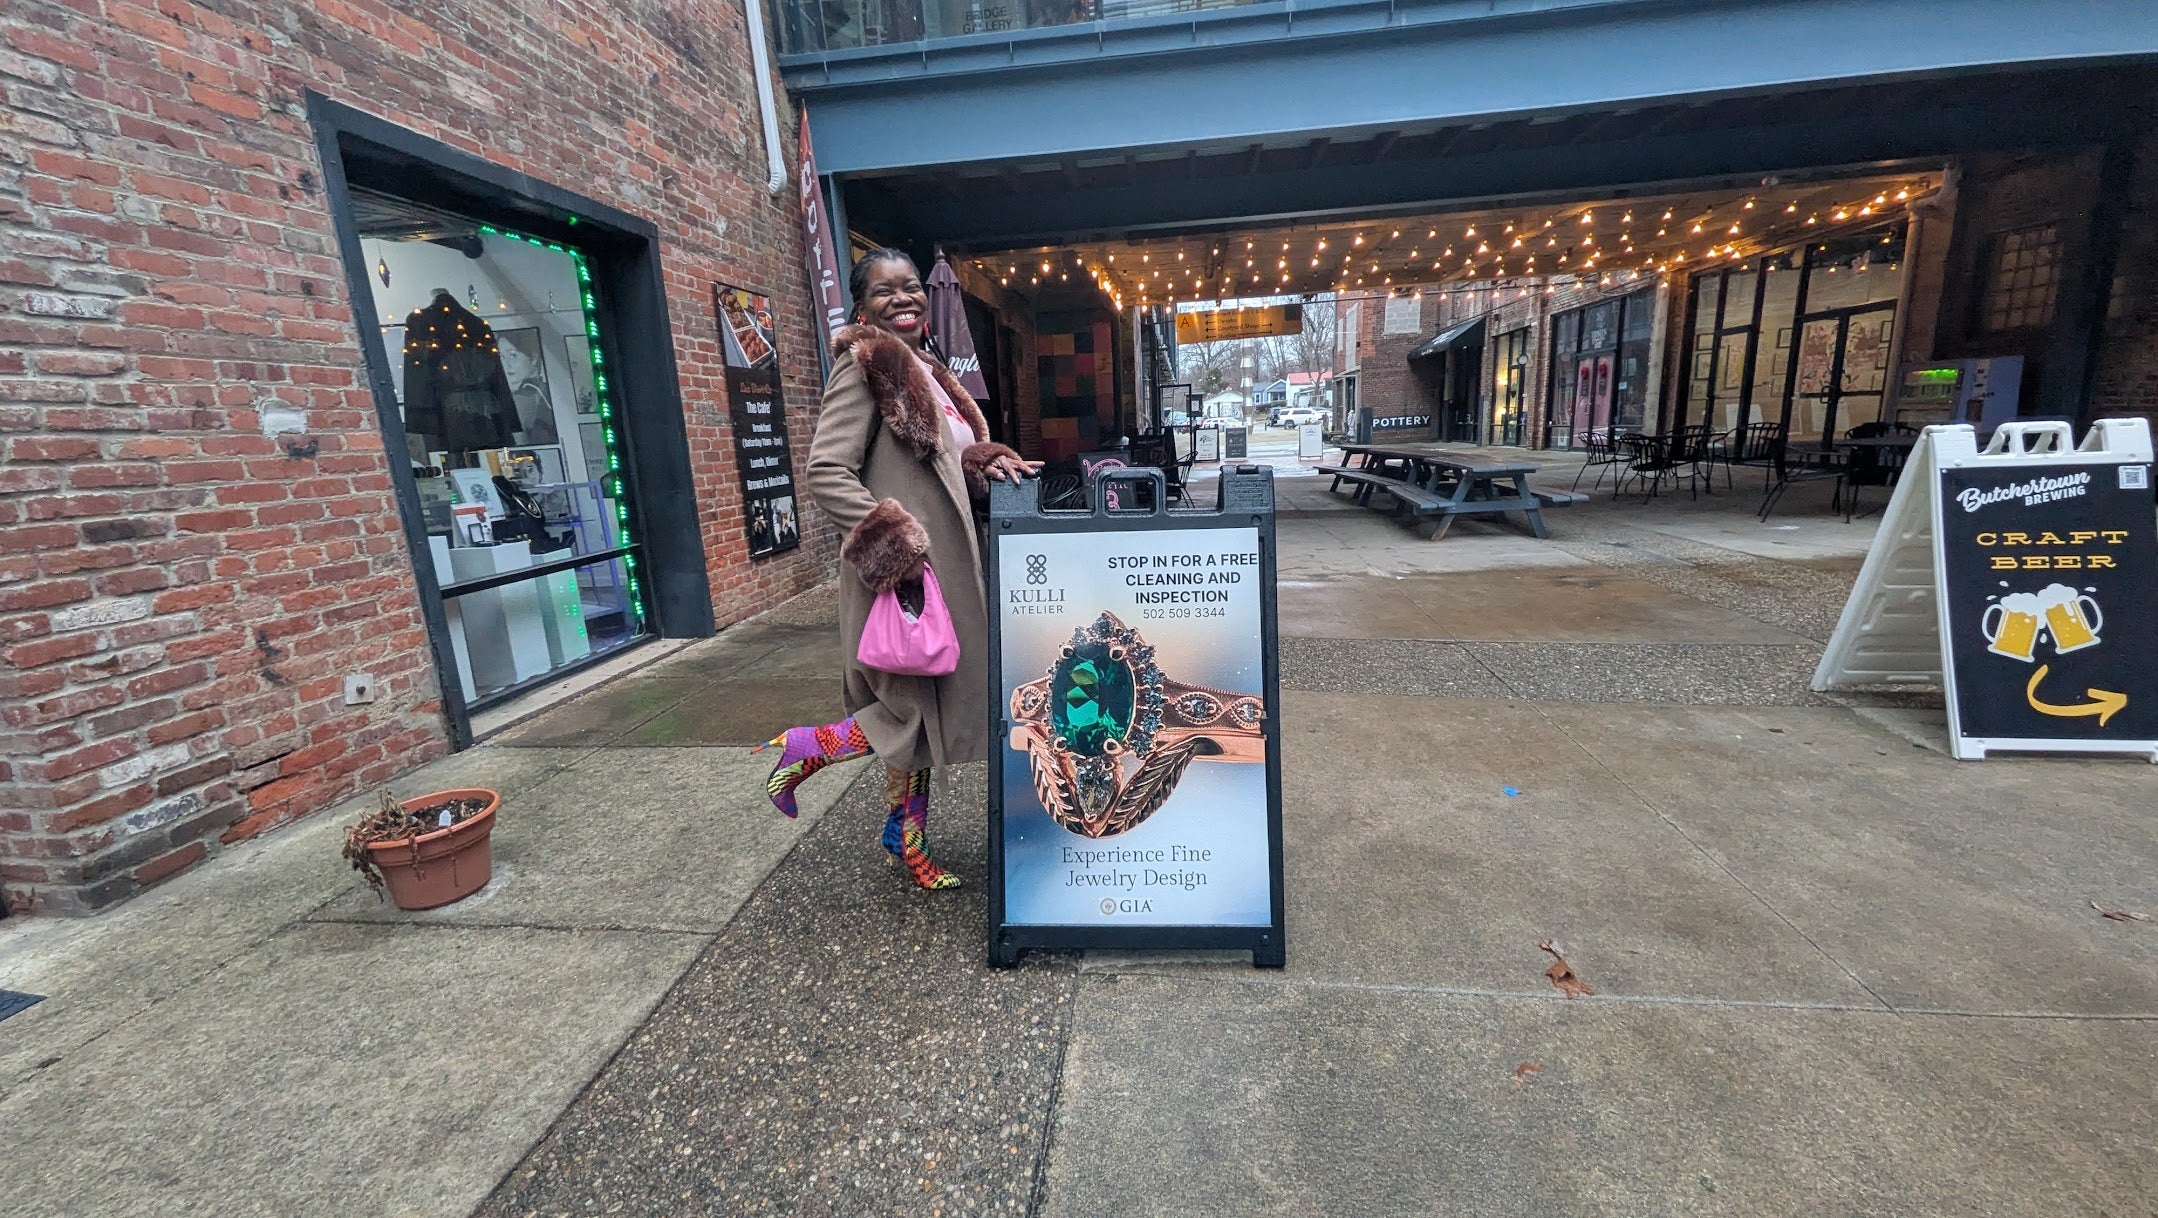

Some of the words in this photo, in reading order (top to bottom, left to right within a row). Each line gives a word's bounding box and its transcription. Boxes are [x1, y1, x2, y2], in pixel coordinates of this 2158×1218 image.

[1180, 317, 1191, 328] A
[745, 401, 757, 414] The
[1372, 414, 1431, 428] POTTERY
[747, 479, 764, 491] Brews
[1956, 471, 2091, 513] Butchertown
[2024, 485, 2086, 507] BREWING
[1976, 530, 2128, 546] CRAFT
[1107, 555, 1149, 569] STOP
[1152, 555, 1168, 568] IN
[1172, 554, 1202, 567] FOR
[1206, 553, 1217, 567] A
[1220, 552, 1258, 566] FREE
[1990, 555, 2117, 570] BEER
[1125, 572, 1204, 587] CLEANING
[1208, 571, 1241, 585] AND
[1009, 588, 1066, 603] KULLI
[1135, 589, 1229, 604] INSPECTION
[1011, 604, 1065, 615] ATELIER
[1143, 608, 1166, 620] 502
[1168, 607, 1191, 619] 509
[1194, 606, 1226, 618] 3344
[1062, 846, 1165, 869] Experience
[1170, 845, 1212, 862] Fine
[1065, 869, 1137, 892] Jewelry
[1143, 869, 1208, 891] Design
[1119, 899, 1153, 913] GIA
